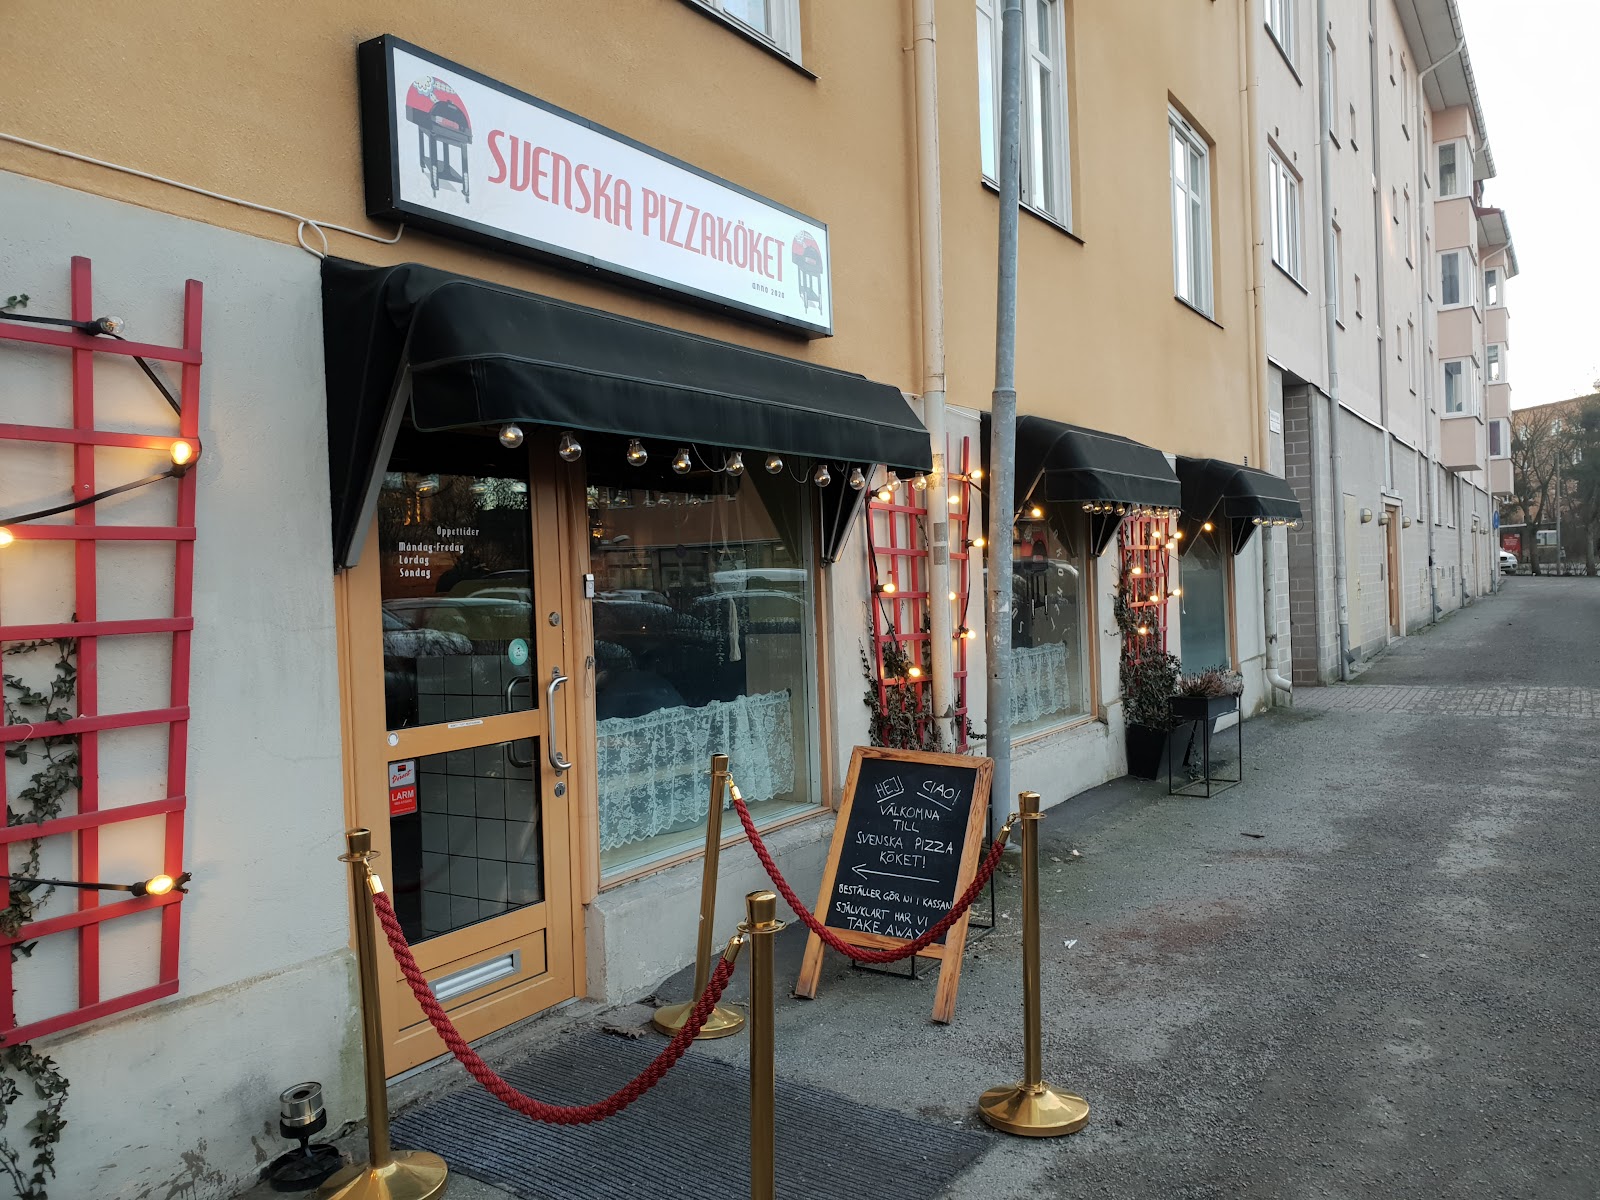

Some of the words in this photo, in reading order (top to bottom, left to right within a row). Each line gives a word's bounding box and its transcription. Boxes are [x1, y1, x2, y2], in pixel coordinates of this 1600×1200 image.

[487, 129, 632, 231] SVENSKA
[641, 186, 785, 282] PIZZAKÖKET
[770, 288, 785, 299] 2020
[399, 555, 429, 566] Lördag
[399, 567, 431, 579] Söndag
[391, 789, 415, 801] LARM
[875, 775, 905, 799] HEJ!
[922, 780, 961, 806] CIAO!
[880, 803, 940, 821] VÄLKOMNA
[893, 819, 920, 833] TILL
[856, 831, 903, 849] SVENSKA
[915, 837, 954, 855] PIZZA
[879, 850, 926, 869] KÖKET!
[838, 883, 882, 901] BESTÄLLER
[882, 890, 901, 902] GÖR
[903, 894, 913, 904] NI
[836, 901, 890, 920] SJÄLVKLART
[894, 911, 912, 925] HAR
[917, 915, 929, 927] VI
[847, 916, 882, 935] TAKE
[884, 924, 927, 940] AWAY
